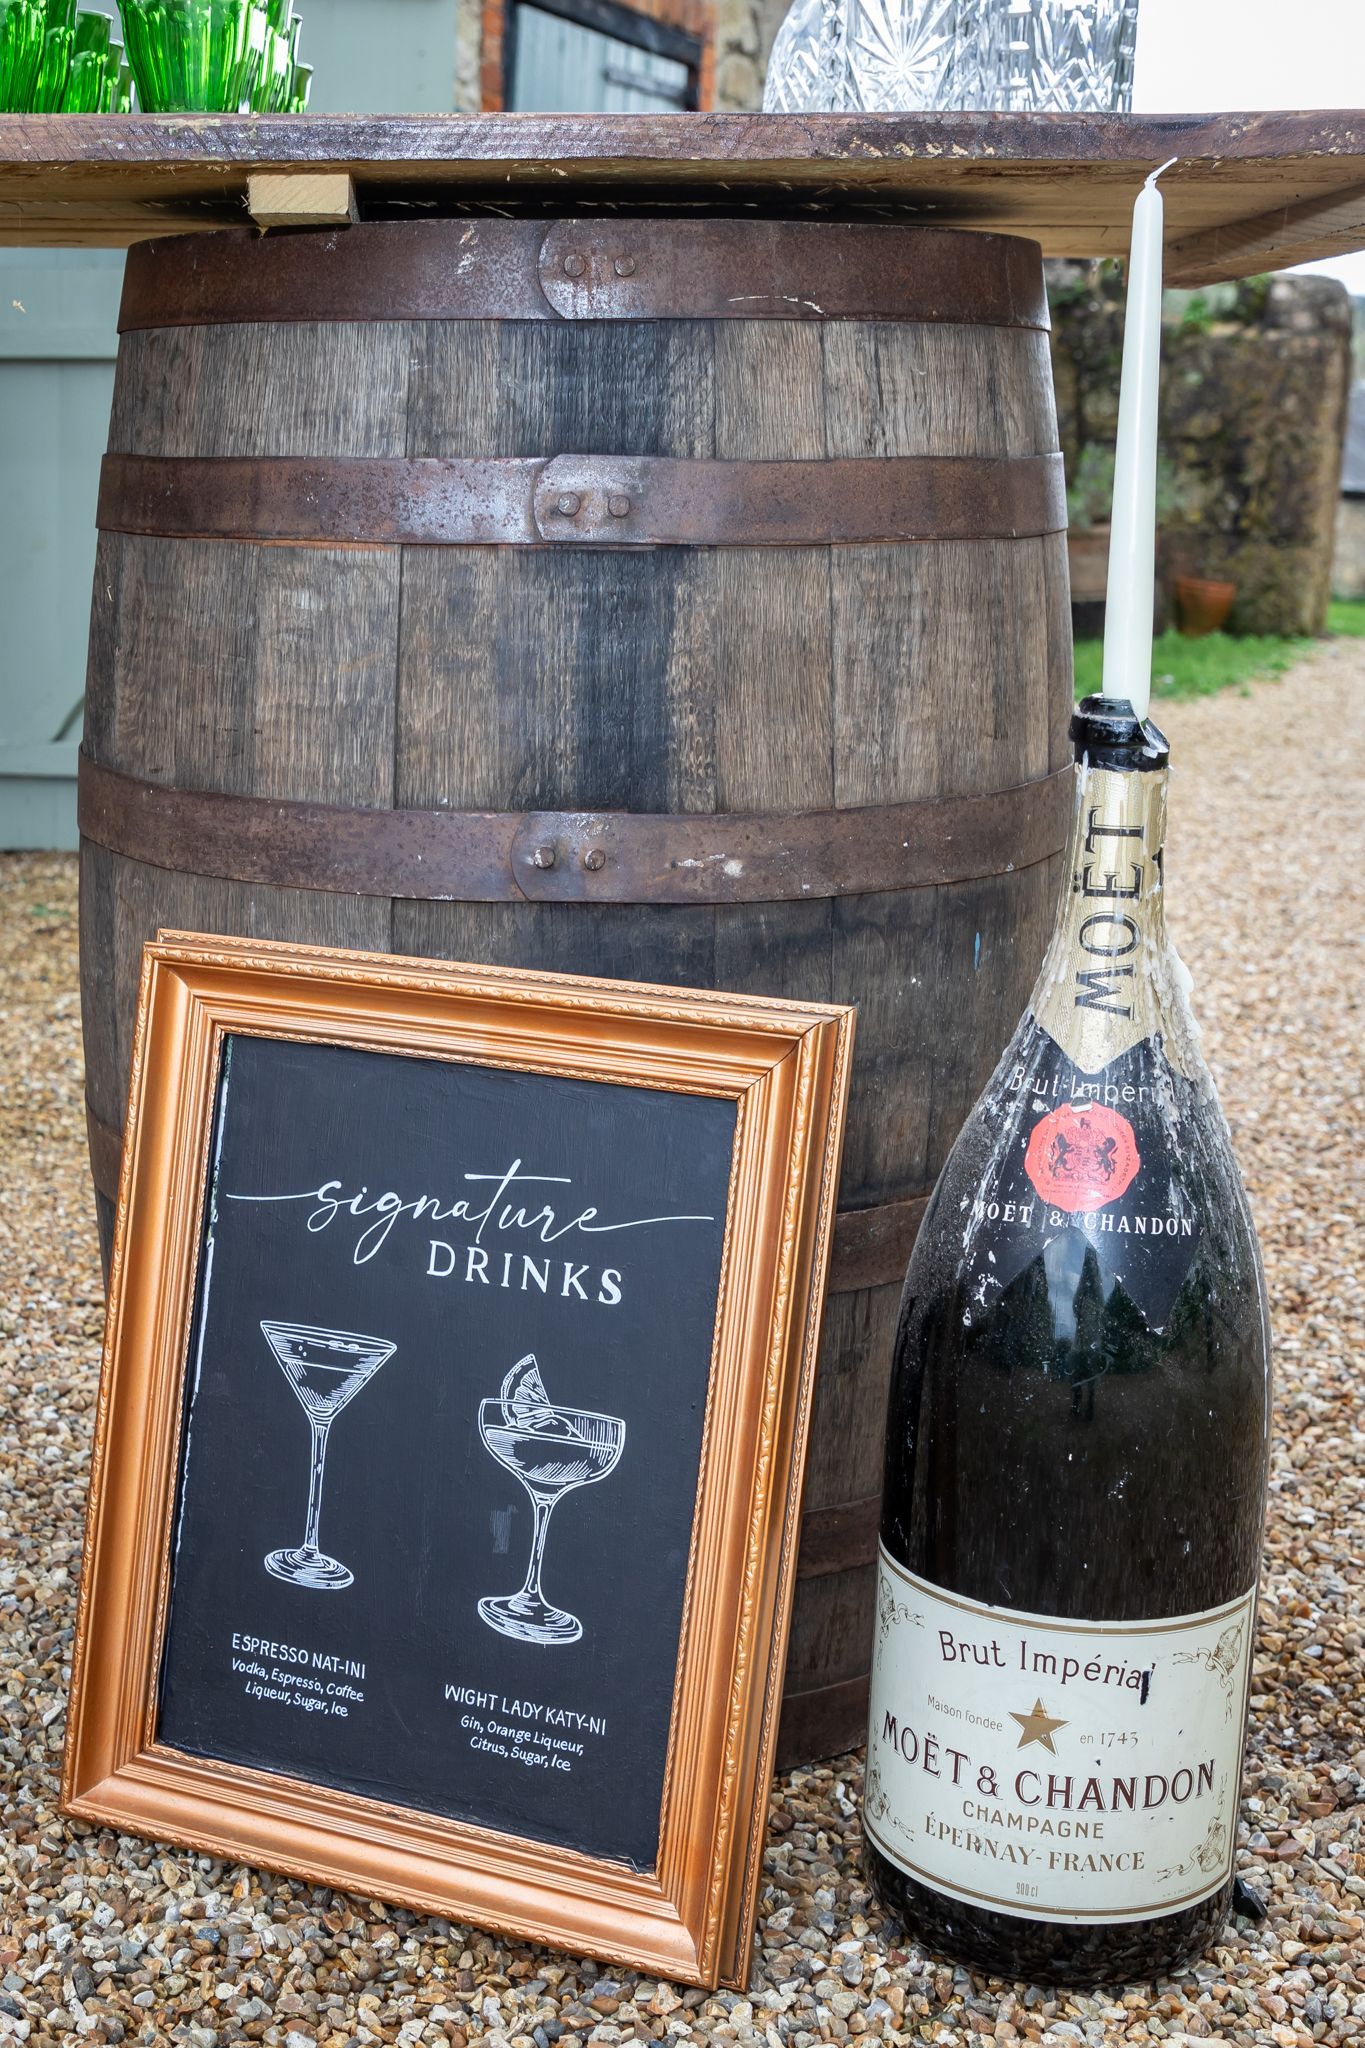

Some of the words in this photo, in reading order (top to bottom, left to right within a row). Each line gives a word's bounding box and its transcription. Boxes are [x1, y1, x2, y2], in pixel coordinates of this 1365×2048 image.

[1072, 805, 1145, 1021] MOËT
[226, 1158, 714, 1264] signature
[1050, 1211, 1068, 1228] &
[1084, 1212, 1193, 1236] CHANDON
[426, 1240, 623, 1305] DRINKS
[231, 1632, 309, 1664] ESPRESSO
[312, 1652, 366, 1680] NAT-INI
[938, 1630, 1006, 1669] Brut
[231, 1657, 269, 1681] Vodka,
[271, 1668, 325, 1695] Espresso,
[326, 1683, 365, 1702] Coffee
[245, 1681, 291, 1705] Liqueur,
[293, 1693, 329, 1715] Sugar,
[331, 1701, 349, 1717] Ice
[445, 1684, 498, 1711] WIGHT
[502, 1697, 543, 1720] LADY
[545, 1706, 606, 1735] KATY-NI
[927, 1694, 962, 1720] Maison
[1079, 1733, 1094, 1744] en
[1100, 1731, 1139, 1750] 1743
[460, 1715, 484, 1734] Gin,
[487, 1720, 531, 1744] Orange
[533, 1731, 584, 1756] Liqueur,
[470, 1736, 508, 1758] Citrus,
[510, 1746, 549, 1769] Sugar,
[551, 1753, 571, 1772] Ice
[881, 1709, 972, 1788] MOËT
[976, 1765, 1003, 1800] &
[1015, 1758, 1217, 1813] CHANDON
[962, 1800, 1104, 1840] CHAMPAGNE
[1049, 1851, 1145, 1873] FRANCE
